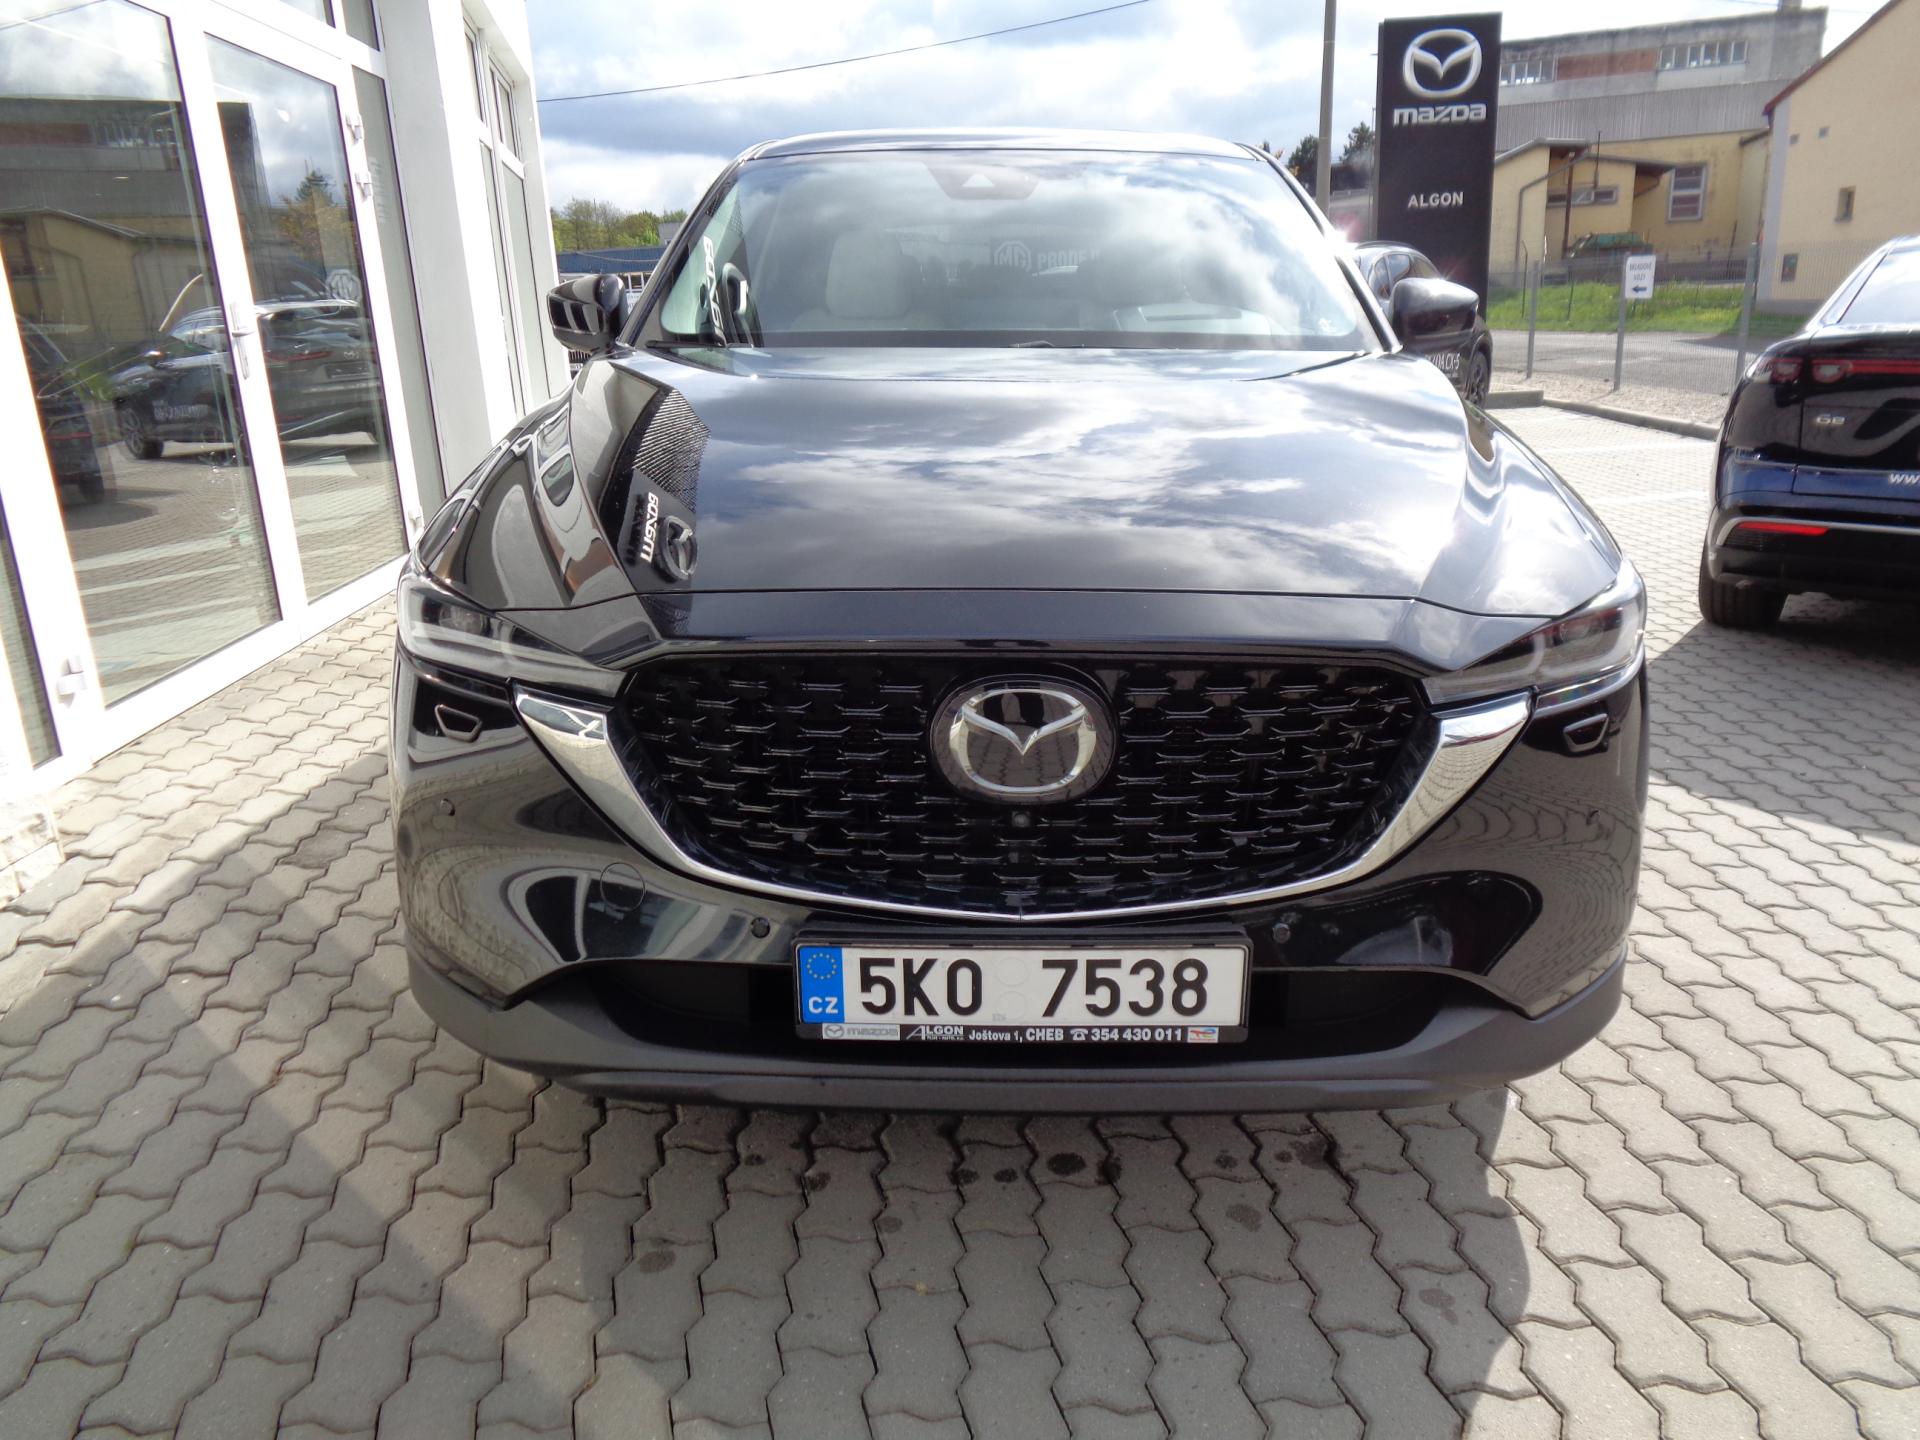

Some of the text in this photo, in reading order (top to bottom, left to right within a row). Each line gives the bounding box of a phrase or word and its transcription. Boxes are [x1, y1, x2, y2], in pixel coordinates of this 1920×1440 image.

[1392, 103, 1487, 127] mazda
[1407, 191, 1464, 209] ALGON
[859, 958, 1209, 1018] 5K0 7538
[808, 997, 839, 1014] CZ
[906, 1025, 964, 1040] ALGON
[968, 1028, 1011, 1041] Joštova
[1025, 1028, 1064, 1041] CHEB
[1091, 1027, 1120, 1041] 354
[1122, 1027, 1152, 1041] 430
[1154, 1027, 1182, 1041] 011
